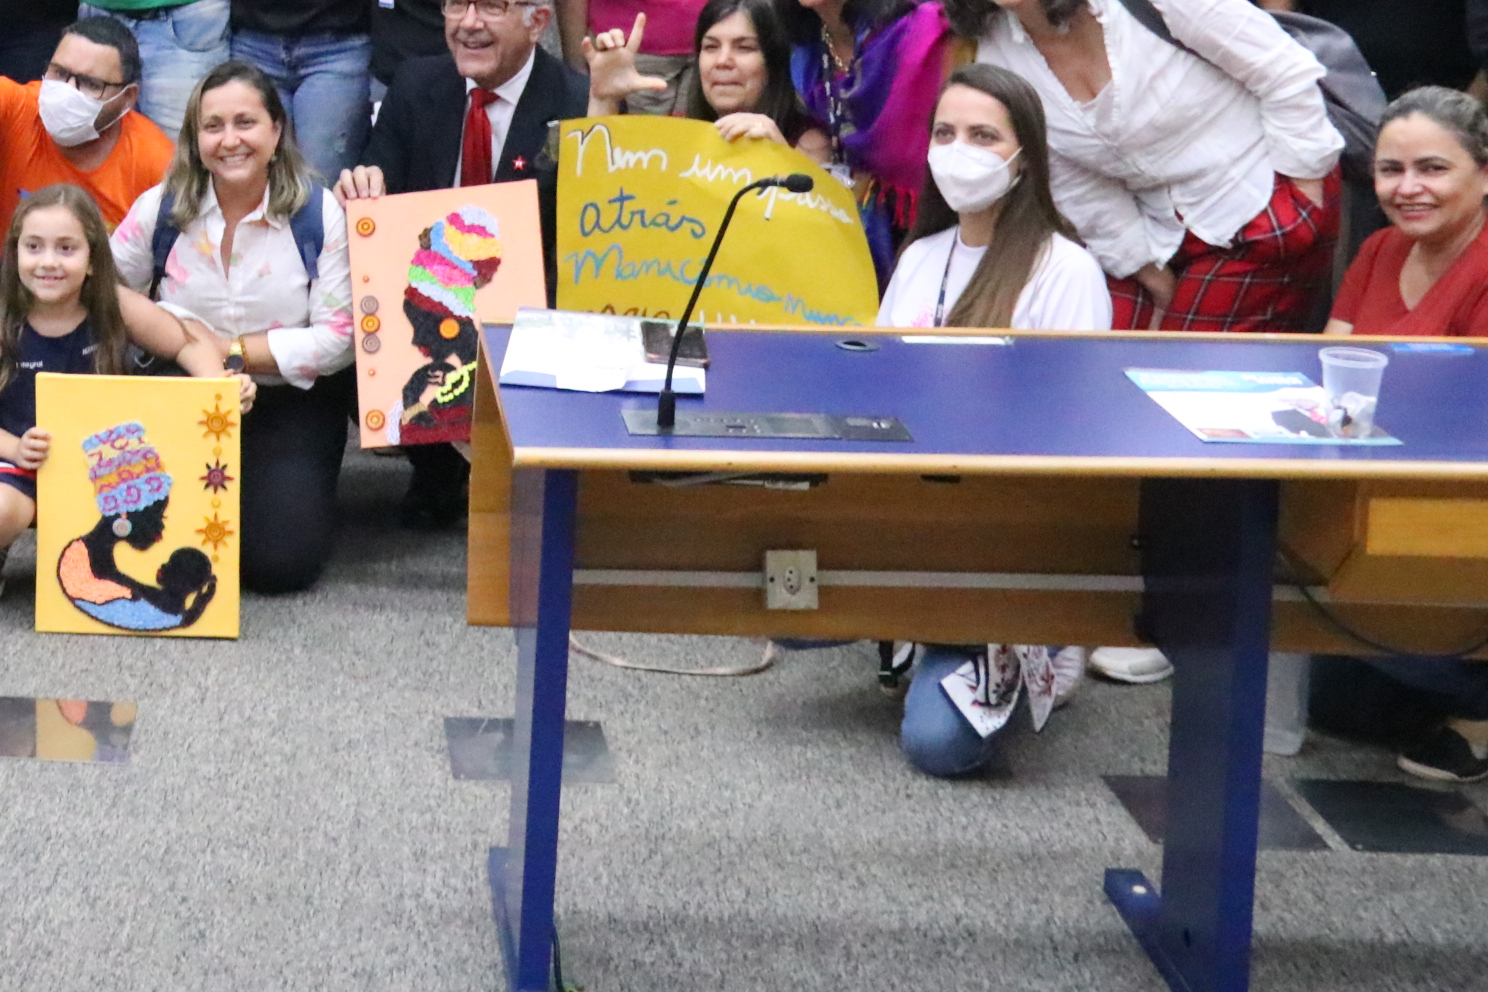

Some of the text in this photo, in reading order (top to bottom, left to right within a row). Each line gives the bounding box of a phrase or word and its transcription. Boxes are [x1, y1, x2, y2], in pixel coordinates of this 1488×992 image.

[567, 123, 668, 177] Nem
[678, 152, 752, 185] um
[579, 186, 706, 239] atrás
